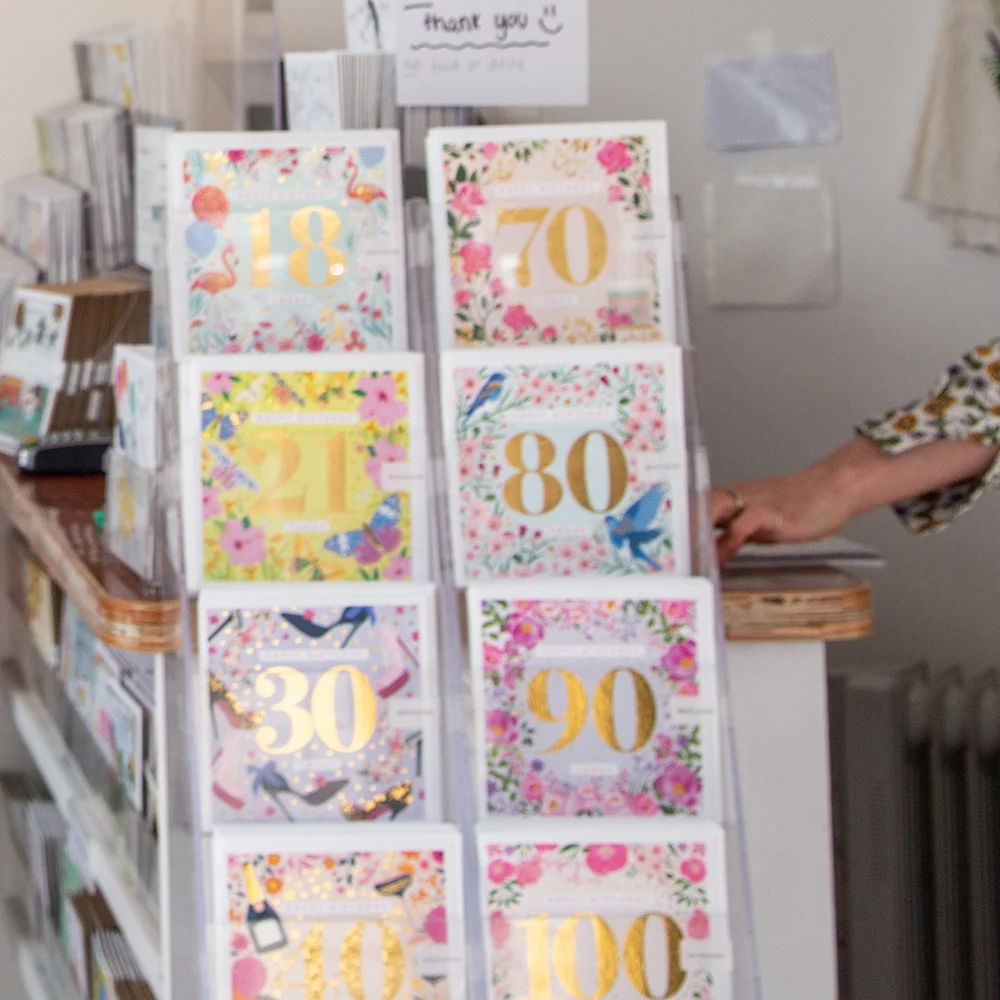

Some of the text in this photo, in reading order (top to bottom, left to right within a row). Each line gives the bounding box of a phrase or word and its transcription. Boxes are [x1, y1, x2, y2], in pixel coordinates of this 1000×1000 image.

[424, 11, 529, 42] thank you
[240, 204, 348, 291] 18
[495, 202, 609, 288] 70
[245, 431, 357, 515] 21
[502, 428, 629, 516] 80
[254, 663, 378, 756] 30
[526, 666, 657, 755] 90
[273, 919, 406, 1000] 40
[512, 909, 688, 1000] 100
